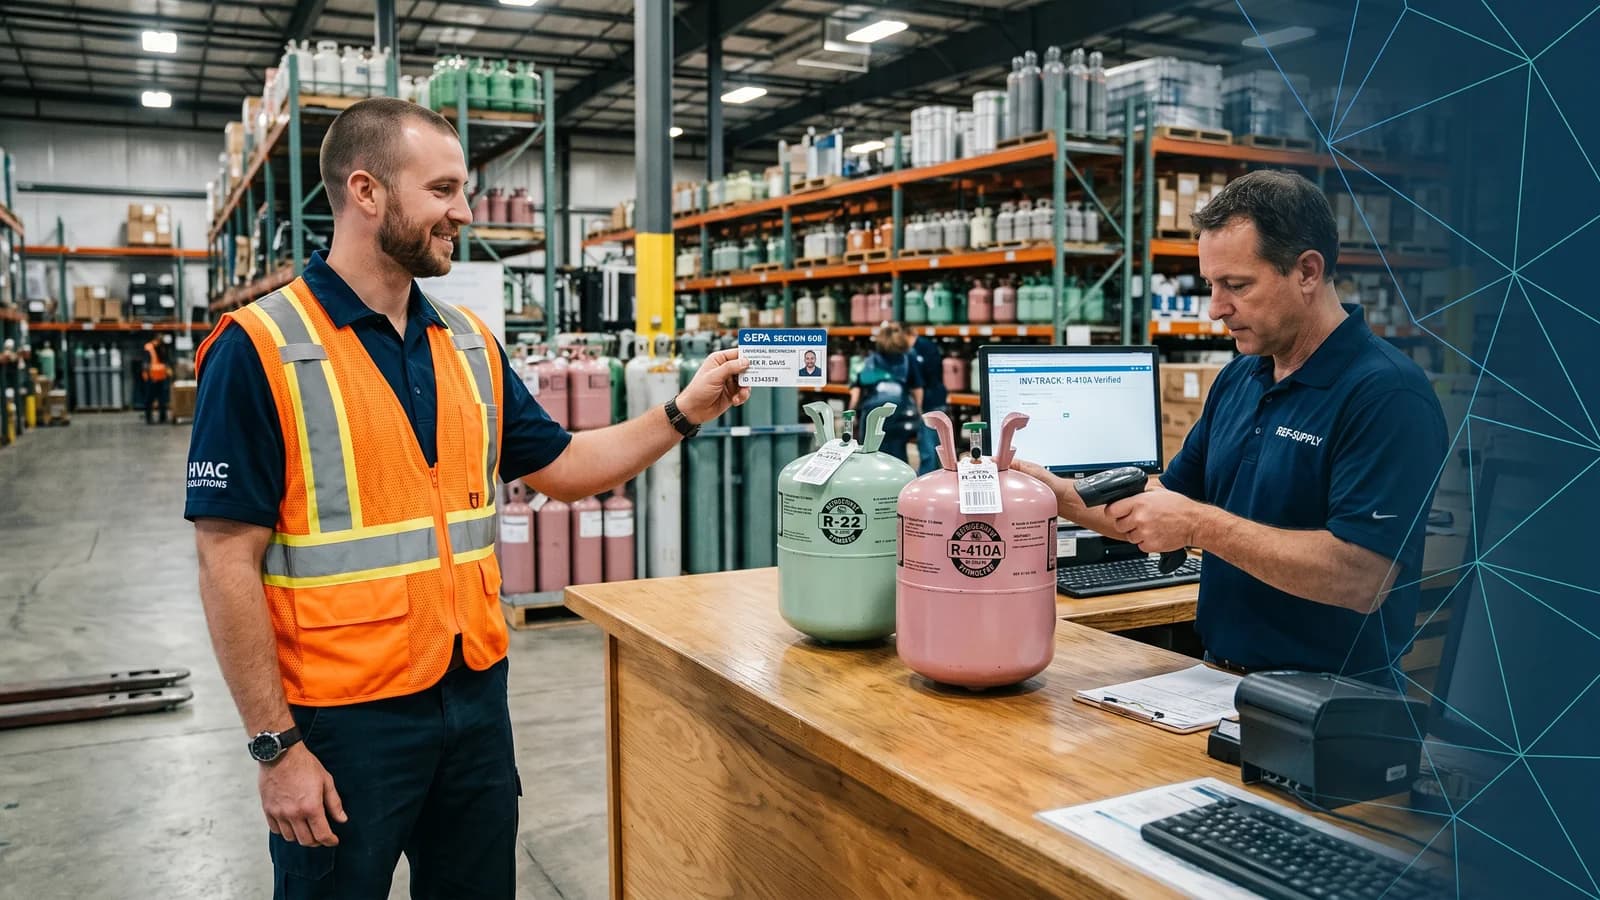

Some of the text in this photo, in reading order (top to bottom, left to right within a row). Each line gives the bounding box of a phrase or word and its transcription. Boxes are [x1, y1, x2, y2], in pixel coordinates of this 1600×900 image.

[752, 333, 770, 342] EPA
[773, 334, 805, 342] SECTION
[1019, 376, 1121, 385] INV-TRACK: R-410A Verified
[1275, 426, 1323, 447] REF-SUPPLY
[188, 461, 229, 479] HVAC
[187, 479, 228, 489] SOLUTIONS
[823, 515, 861, 528] R-22
[951, 544, 1002, 557] R-410A
